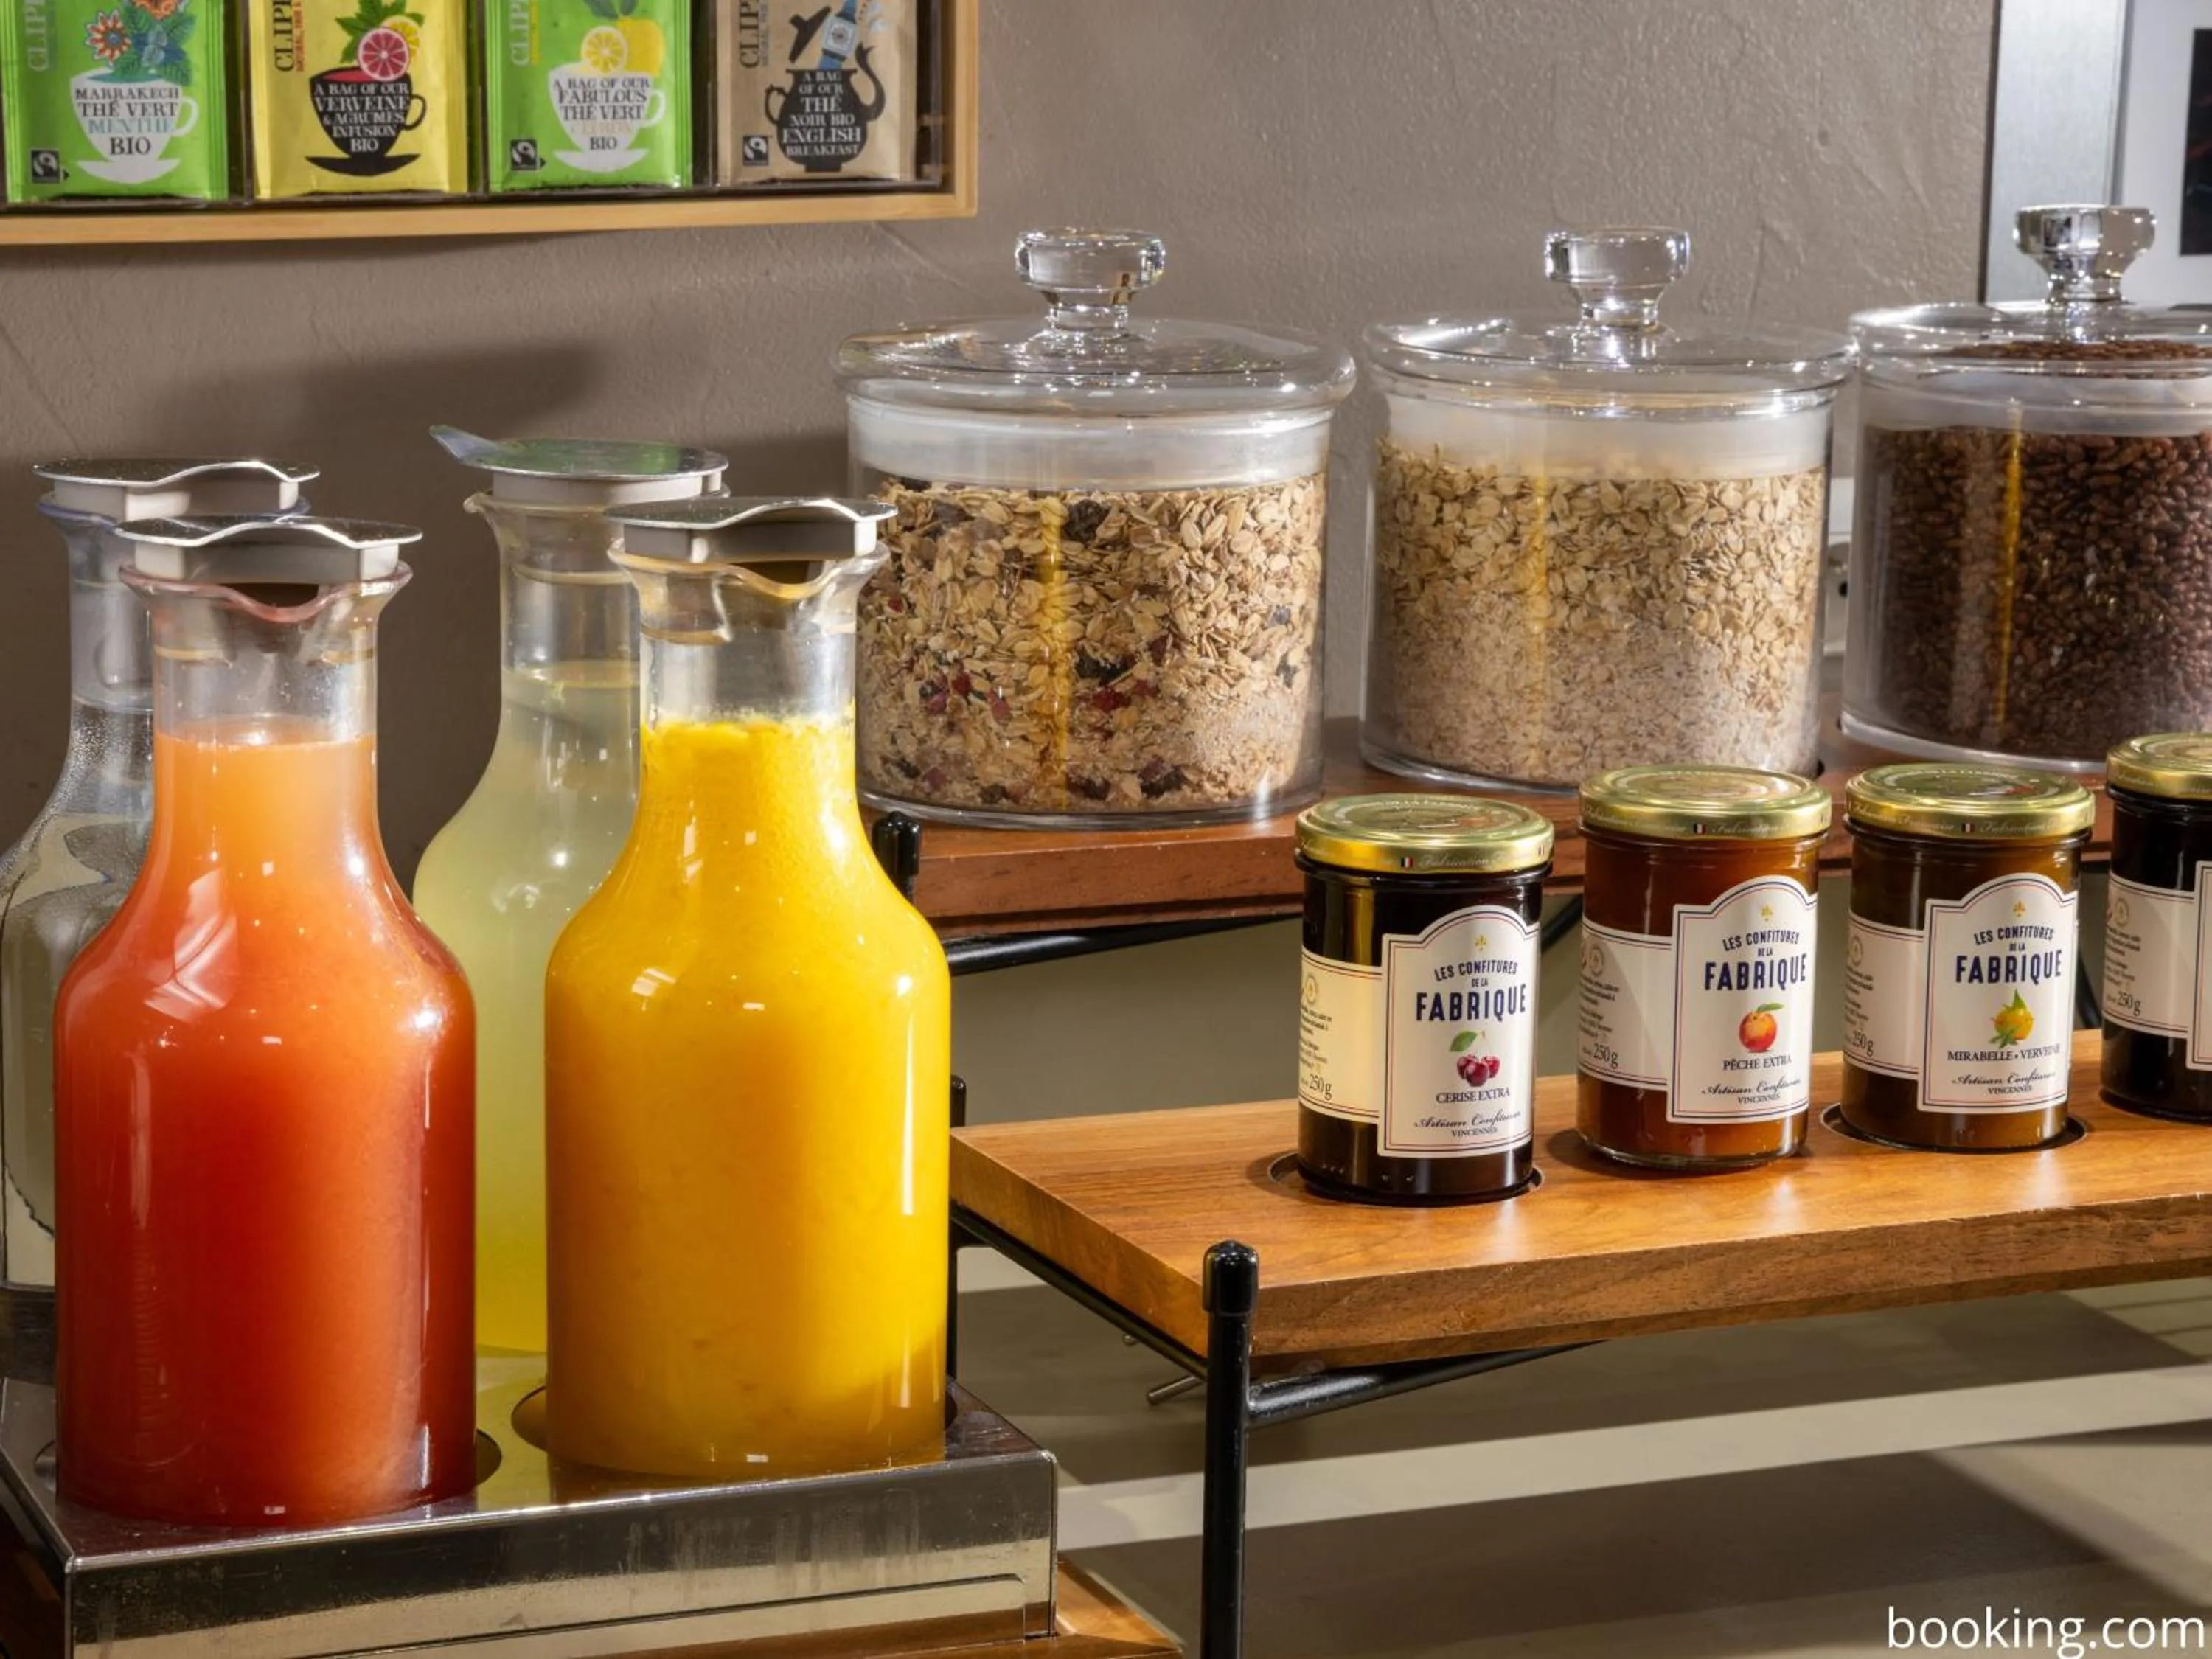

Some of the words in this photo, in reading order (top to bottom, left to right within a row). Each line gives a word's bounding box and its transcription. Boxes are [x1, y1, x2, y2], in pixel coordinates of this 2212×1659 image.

[315, 83, 324, 95] A
[329, 83, 358, 95] BAG
[361, 83, 378, 94] OF
[380, 83, 409, 94] OUR
[568, 77, 597, 88] BAG
[600, 77, 618, 88] OF
[622, 77, 650, 88] OUR
[75, 87, 179, 100] MARRAKECH
[559, 88, 647, 104] FABULOUS
[78, 100, 120, 117] THÉ
[126, 102, 178, 117] VERT
[314, 96, 409, 111] VERVEINE
[800, 94, 842, 112] THÉ
[333, 111, 406, 125] AGRUMES
[560, 104, 597, 120] THÉ
[600, 105, 644, 120] VERT
[790, 114, 827, 127] NOIR
[830, 114, 855, 125] BIO
[332, 125, 397, 138] INFUSION
[782, 127, 861, 144] ENGLISH
[110, 136, 152, 156] BIO
[350, 138, 379, 152] BIO
[590, 136, 618, 150] BIO
[786, 144, 858, 157] BREAKFAST
[1722, 935, 1742, 952] LES
[1745, 929, 1801, 945] CONFITURES
[1974, 929, 1993, 945] LES
[1997, 925, 2054, 941] CONFITURES
[1757, 947, 1765, 956] DE
[1766, 947, 1773, 956] LA
[2009, 942, 2017, 951] DE
[2018, 942, 2025, 951] LA
[1434, 965, 1455, 981] LES
[1458, 959, 1519, 975] CONFITURES
[1704, 953, 1807, 991] FABRIQUE
[1955, 949, 2062, 986] FABRIQUE
[1471, 978, 1479, 987] DE
[1481, 978, 1488, 987] LA
[1416, 983, 1526, 1022] FABRIQUE
[1723, 1057, 1760, 1071] PÊCHE
[1763, 1054, 1792, 1068] EXTRA
[1947, 1050, 2013, 1062] MIRABELLE
[1951, 1073, 2003, 1085] Artisan
[1436, 1091, 1477, 1104] CERISE
[1478, 1086, 1511, 1101] EXTRA
[1701, 1083, 1752, 1095] Artisan
[1413, 1116, 1467, 1128] Artisan
